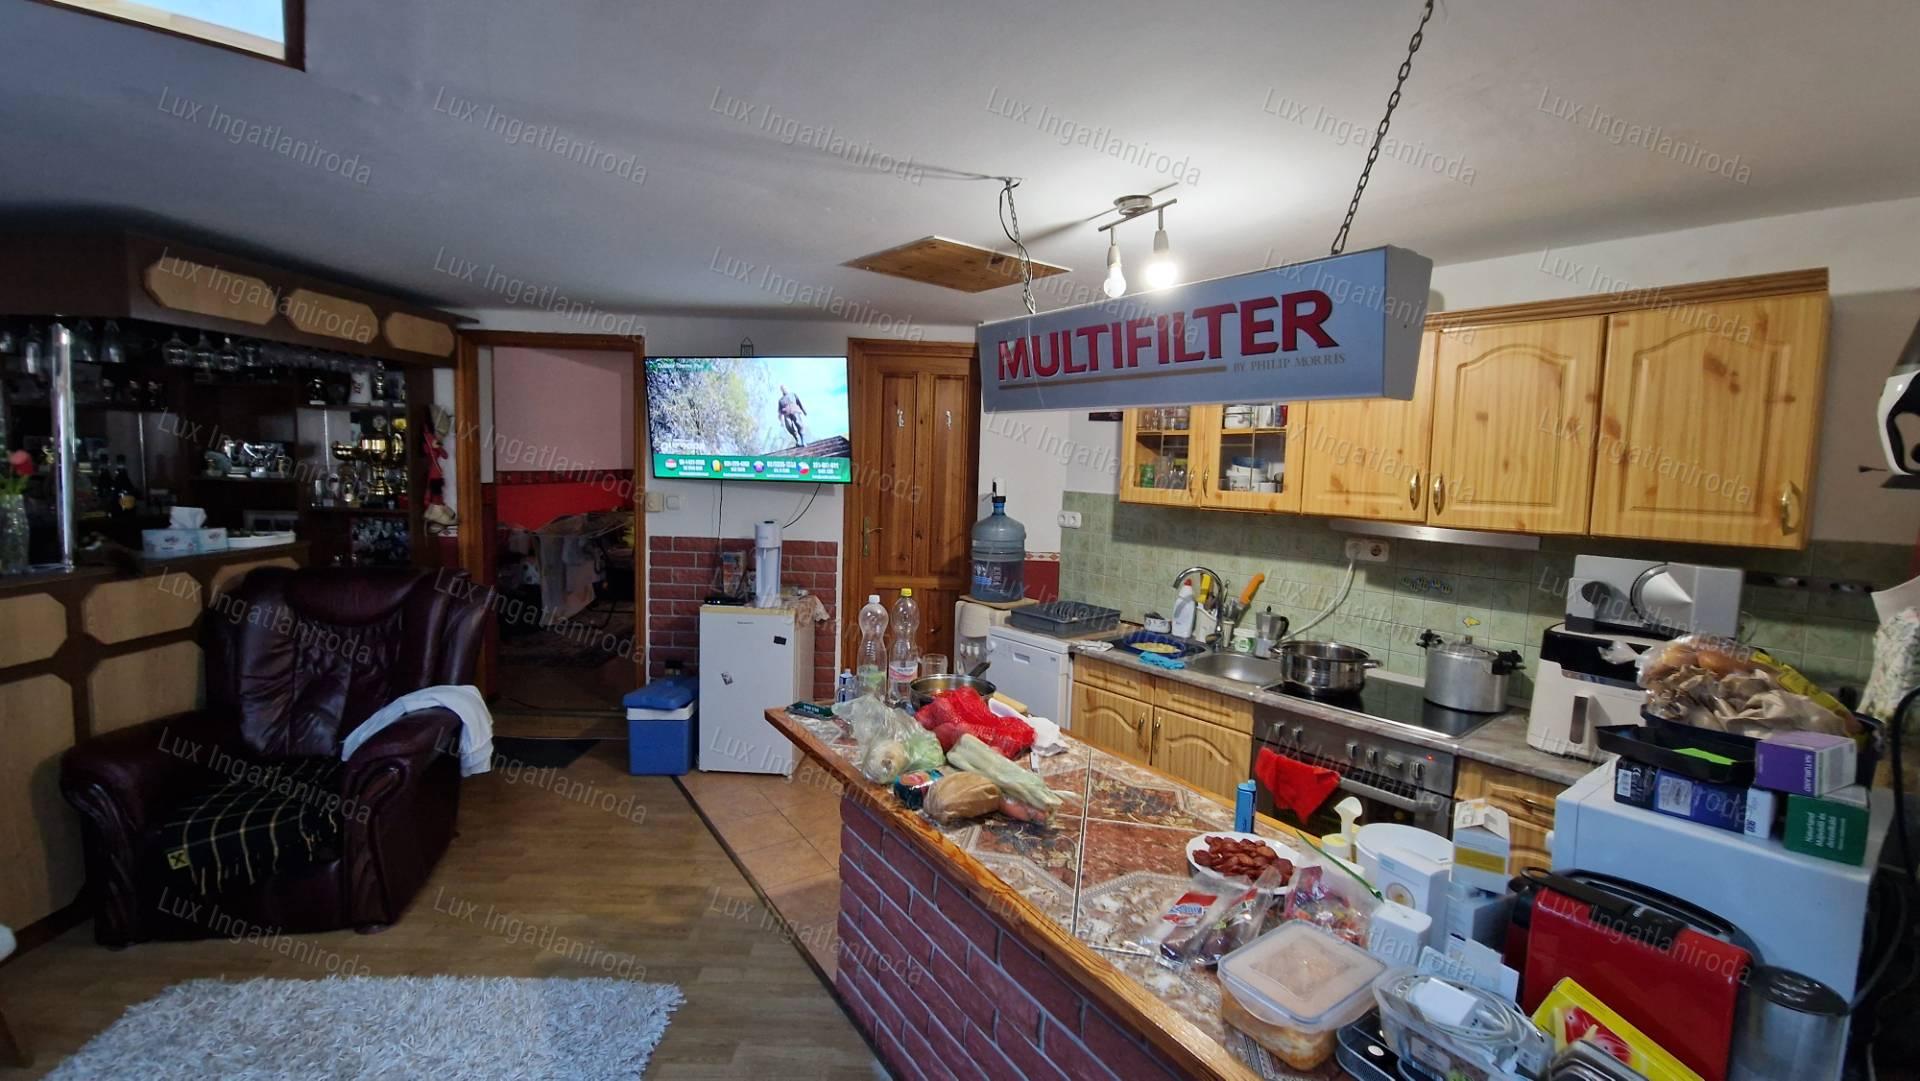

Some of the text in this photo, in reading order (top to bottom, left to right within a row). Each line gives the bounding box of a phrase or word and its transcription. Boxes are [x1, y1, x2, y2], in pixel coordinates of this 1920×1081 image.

[999, 289, 1340, 381] MULTIFILTER
[1233, 352, 1346, 373] BY PHILIP MORRIS
